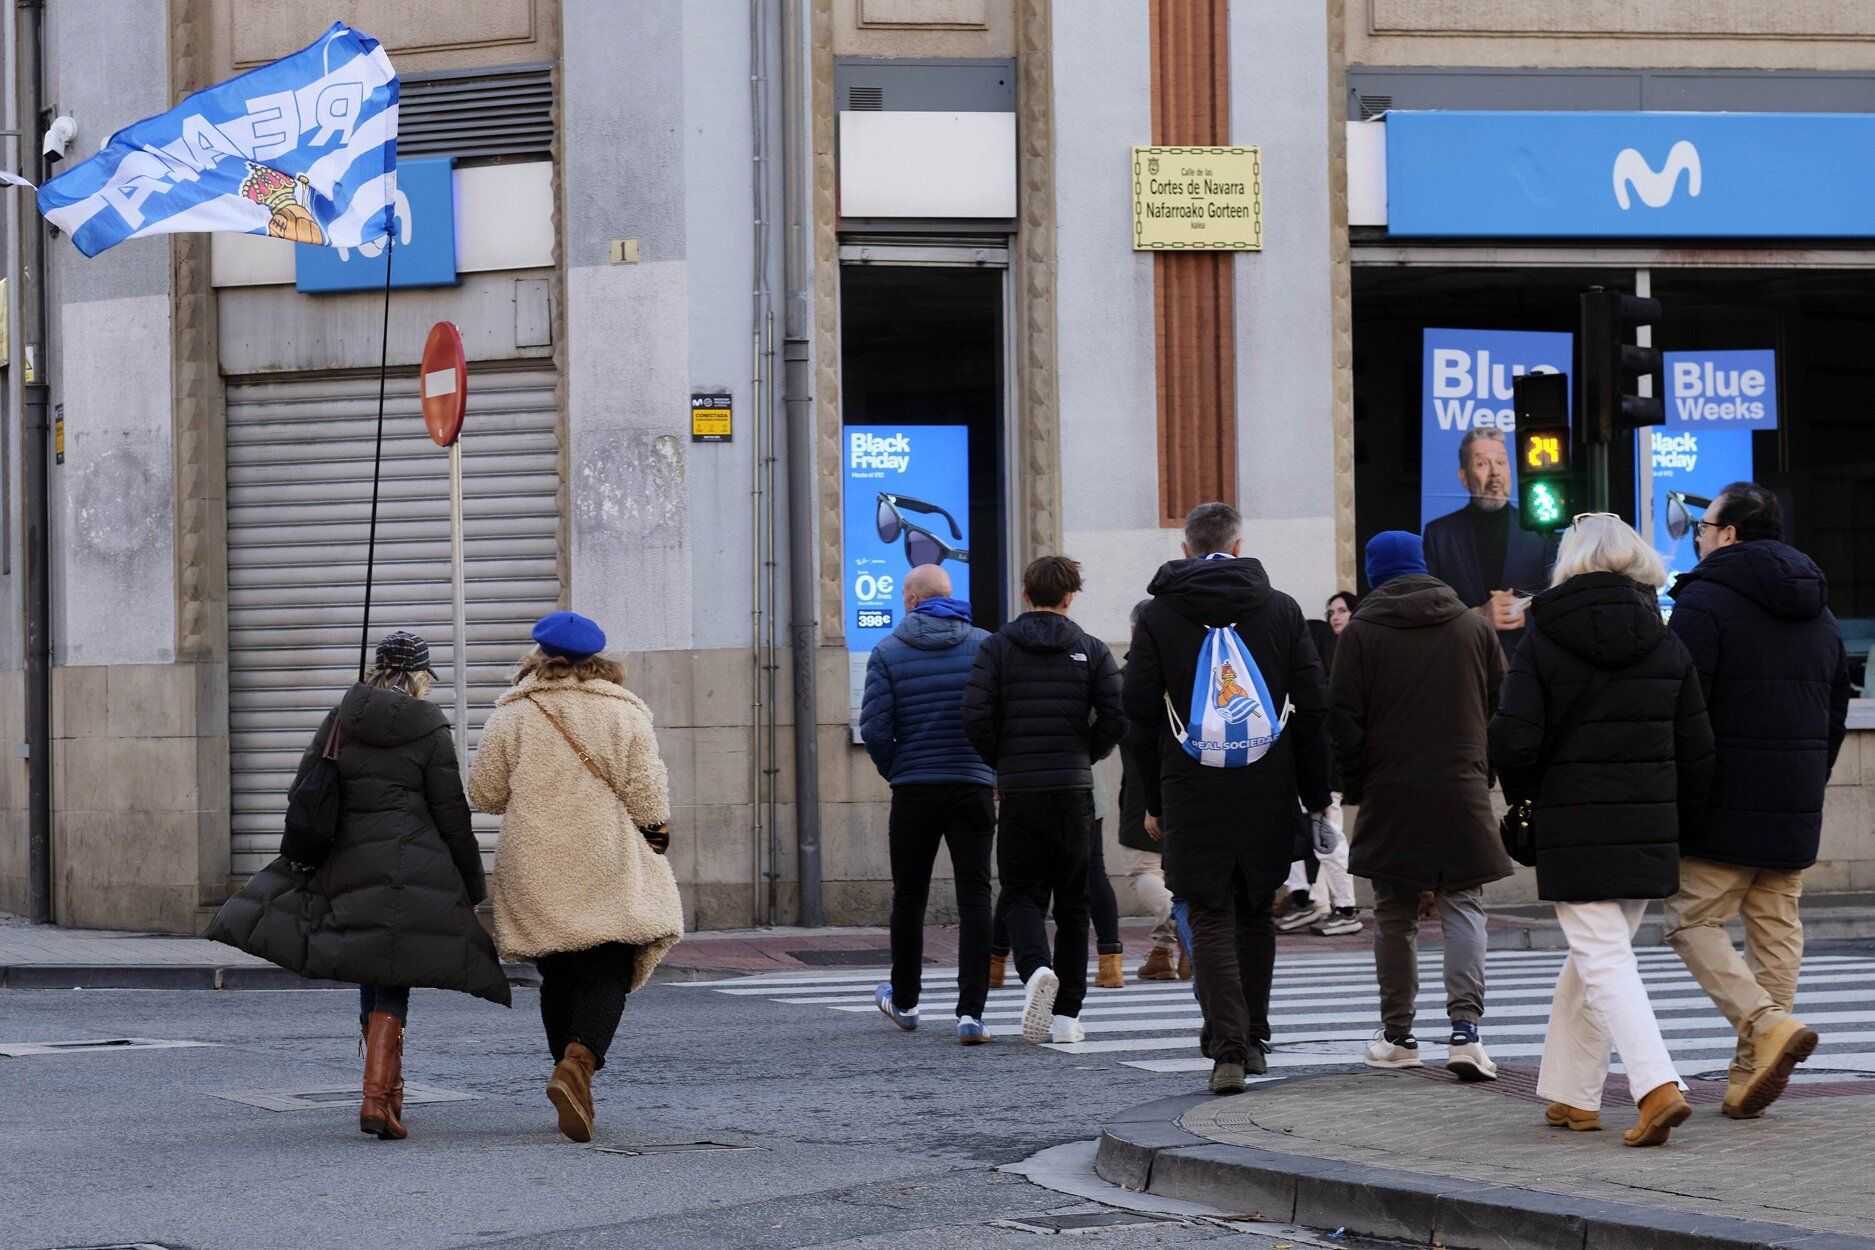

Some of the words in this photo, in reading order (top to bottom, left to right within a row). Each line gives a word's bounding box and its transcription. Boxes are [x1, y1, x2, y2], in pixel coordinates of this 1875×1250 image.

[1181, 168, 1195, 176] Calle
[1196, 168, 1203, 176] de
[1204, 168, 1213, 176] las
[1150, 178, 1183, 195] Cortes
[1187, 178, 1200, 195] de
[1204, 179, 1245, 195] Navarra
[1146, 202, 1204, 218] Nafarroako
[1207, 202, 1249, 218] Gorteen
[1433, 349, 1560, 400] Blu
[1673, 361, 1766, 398] Blue
[1433, 398, 1516, 432] Wee
[1675, 397, 1765, 420] Weeks
[851, 432, 911, 453] Black
[1528, 436, 1558, 466] 24
[1652, 432, 1698, 452] lack
[851, 451, 910, 473] Friday
[1652, 451, 1698, 472] riday
[855, 574, 894, 601] 0€
